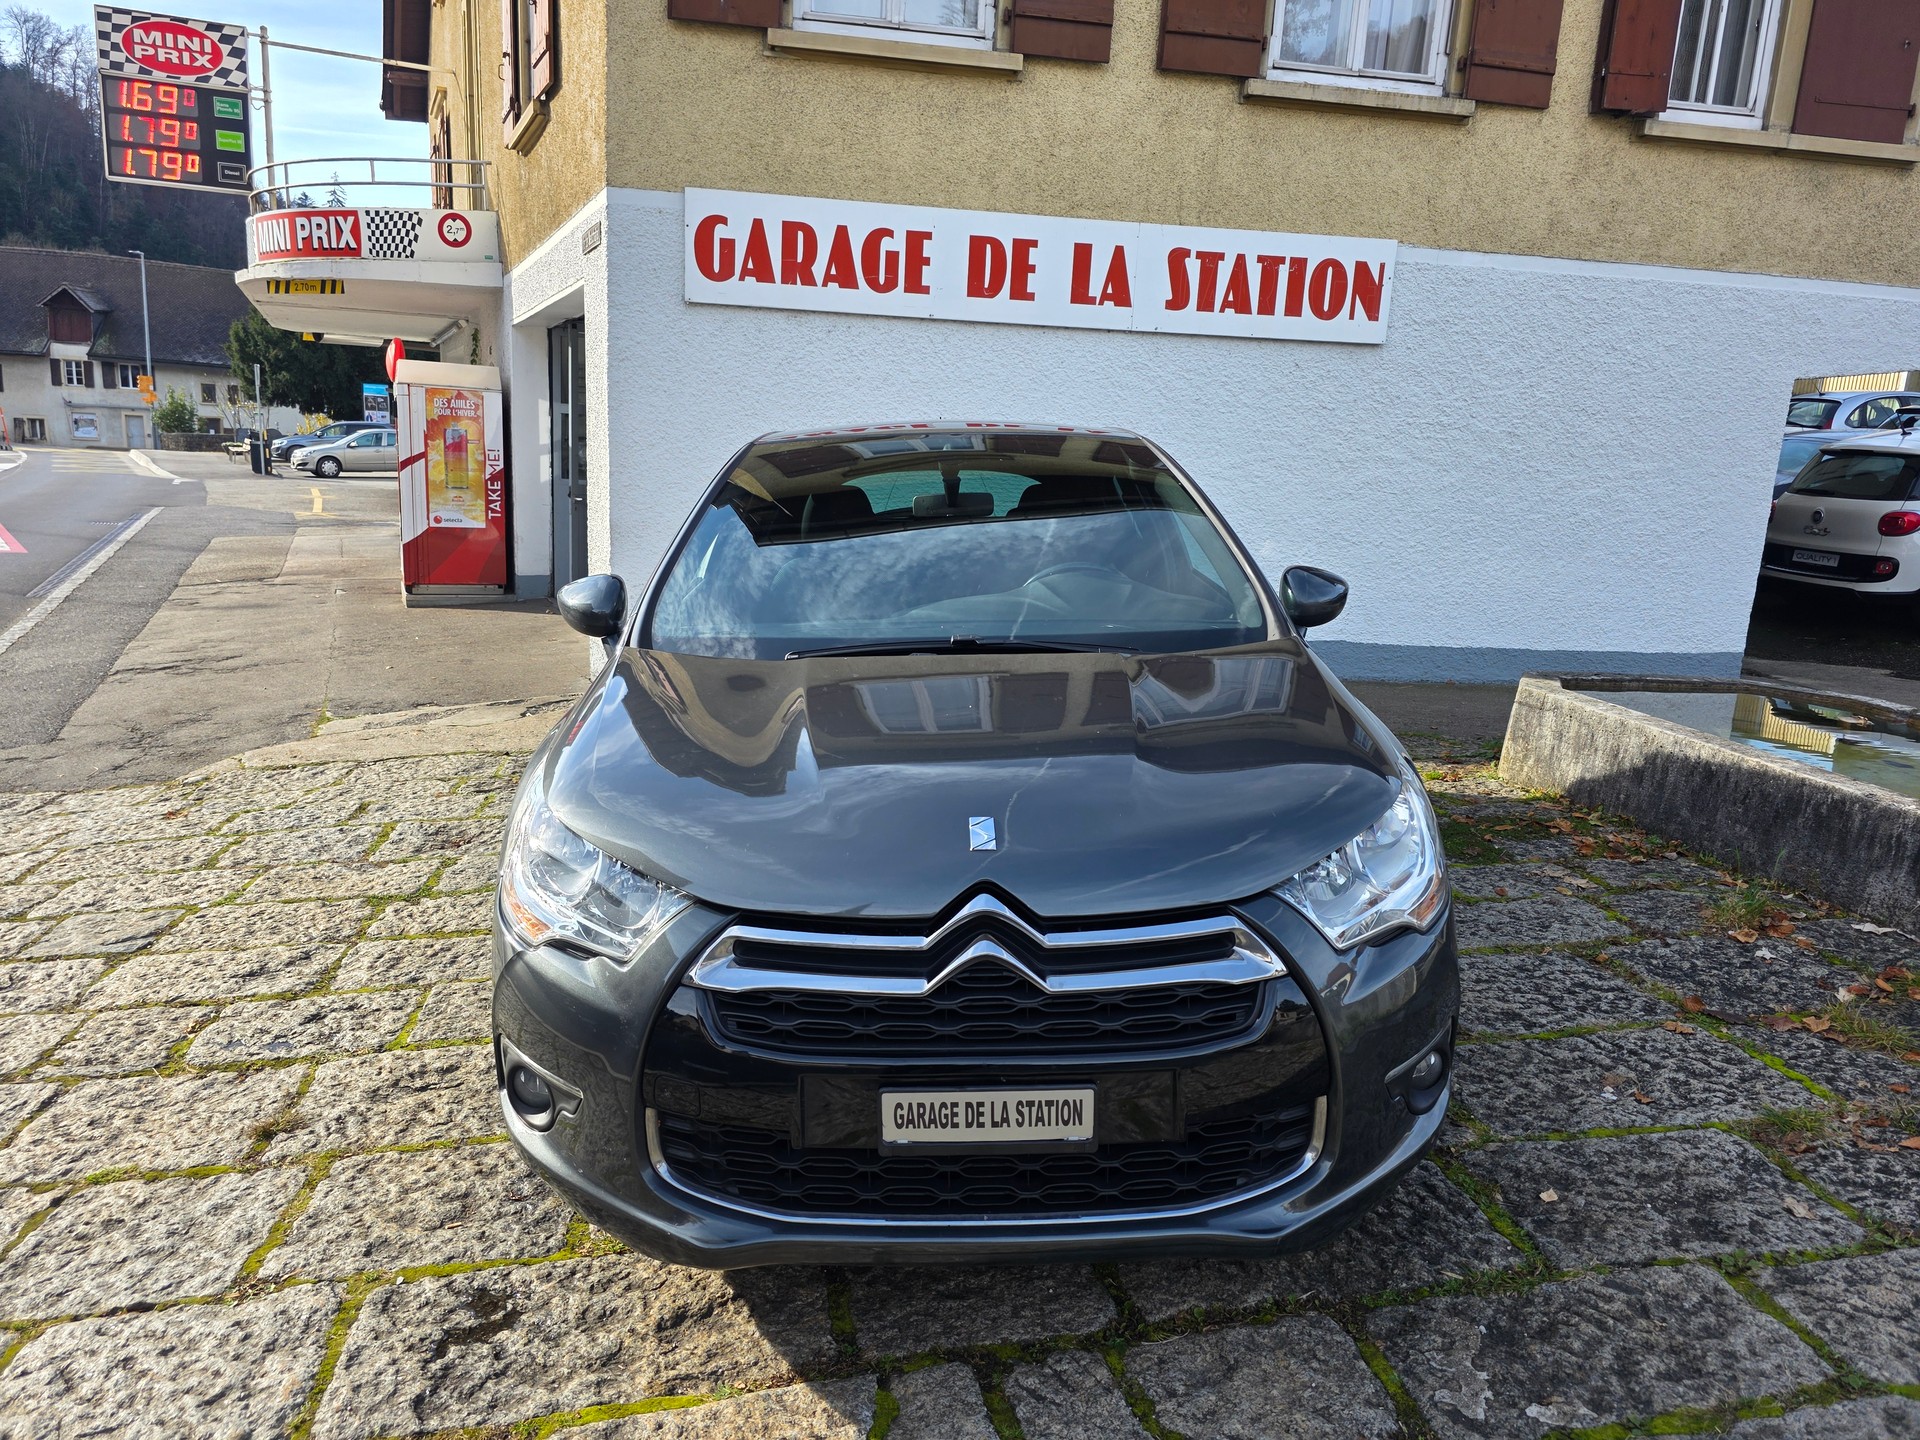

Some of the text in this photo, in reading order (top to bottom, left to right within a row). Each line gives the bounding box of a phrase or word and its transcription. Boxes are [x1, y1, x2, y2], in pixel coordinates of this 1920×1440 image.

[132, 28, 212, 53] MINI
[133, 44, 214, 69] PRIX
[257, 215, 358, 255] MINI PRIX
[693, 214, 1386, 322] GARAGE DE LA STATION
[433, 398, 449, 408] DES
[433, 407, 451, 416] POUR
[487, 448, 501, 520] TAKE ME!
[893, 1099, 1084, 1130] GARAGE DE LA STATION
